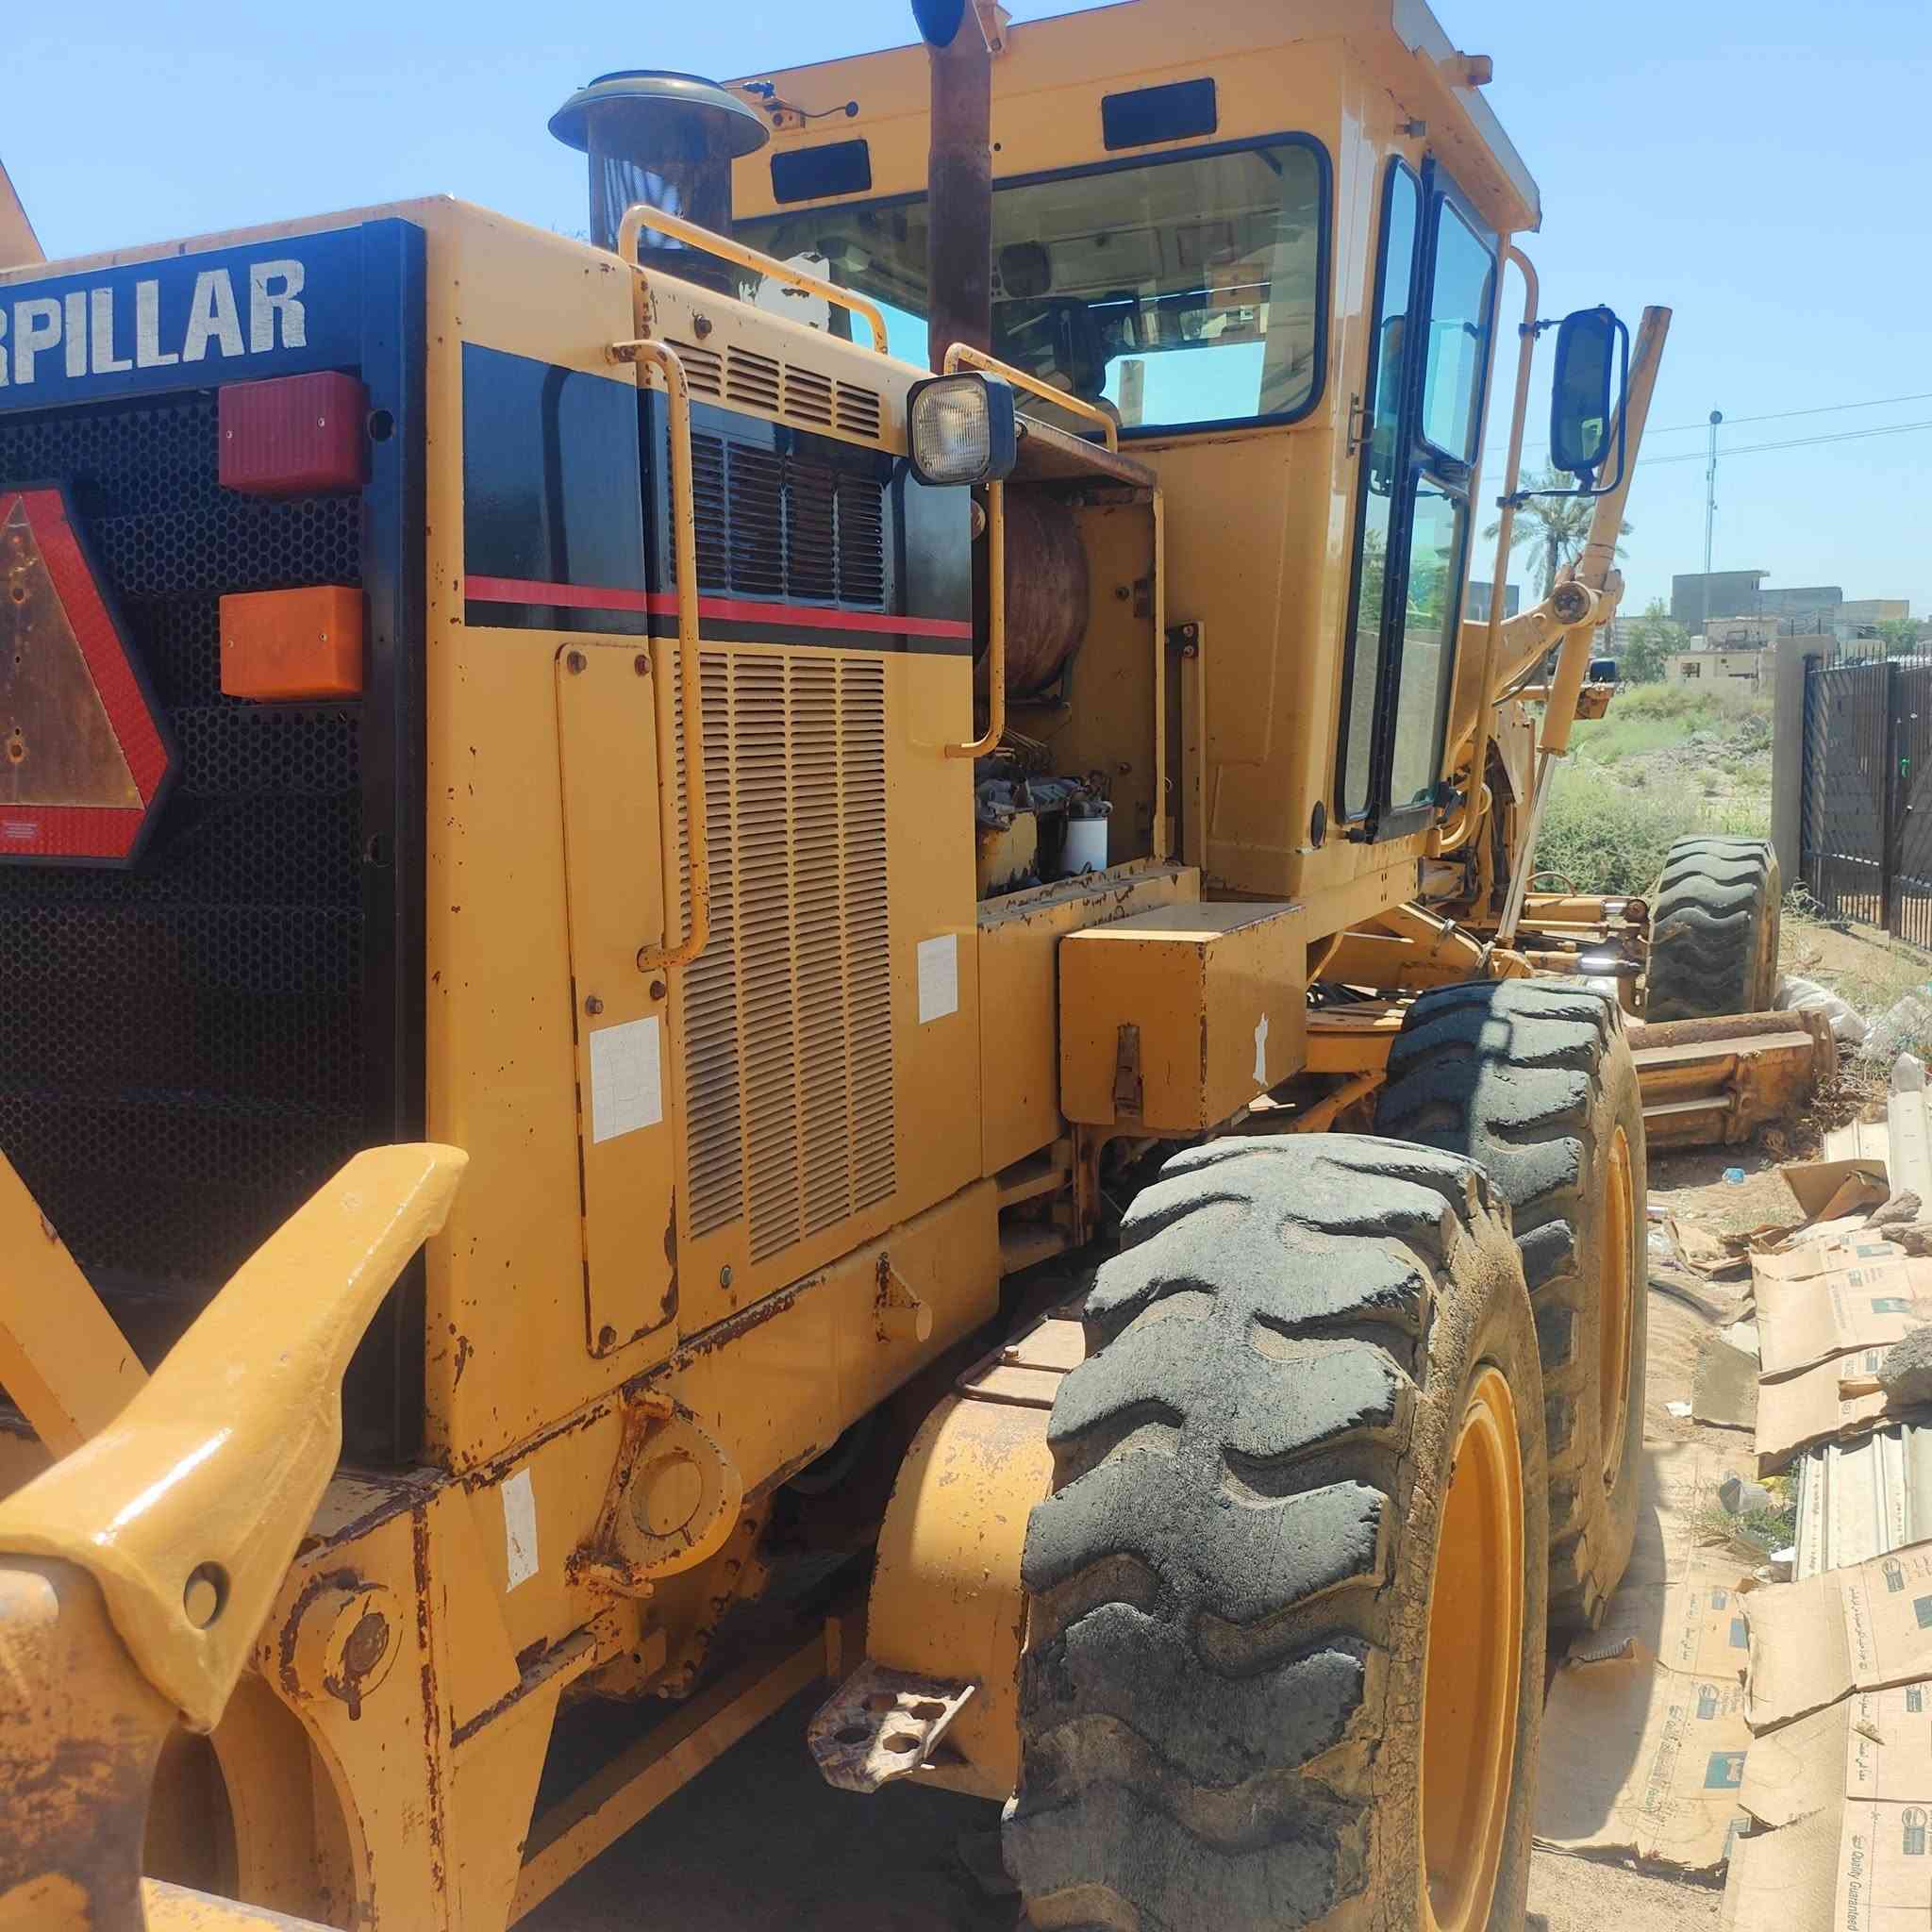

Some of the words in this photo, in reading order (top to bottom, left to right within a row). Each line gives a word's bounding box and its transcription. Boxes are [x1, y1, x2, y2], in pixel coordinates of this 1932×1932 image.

[0, 259, 307, 387] PILLAR
[1847, 1852, 1864, 1879] Quality
[1847, 1881, 1862, 1932] Guaranteed
